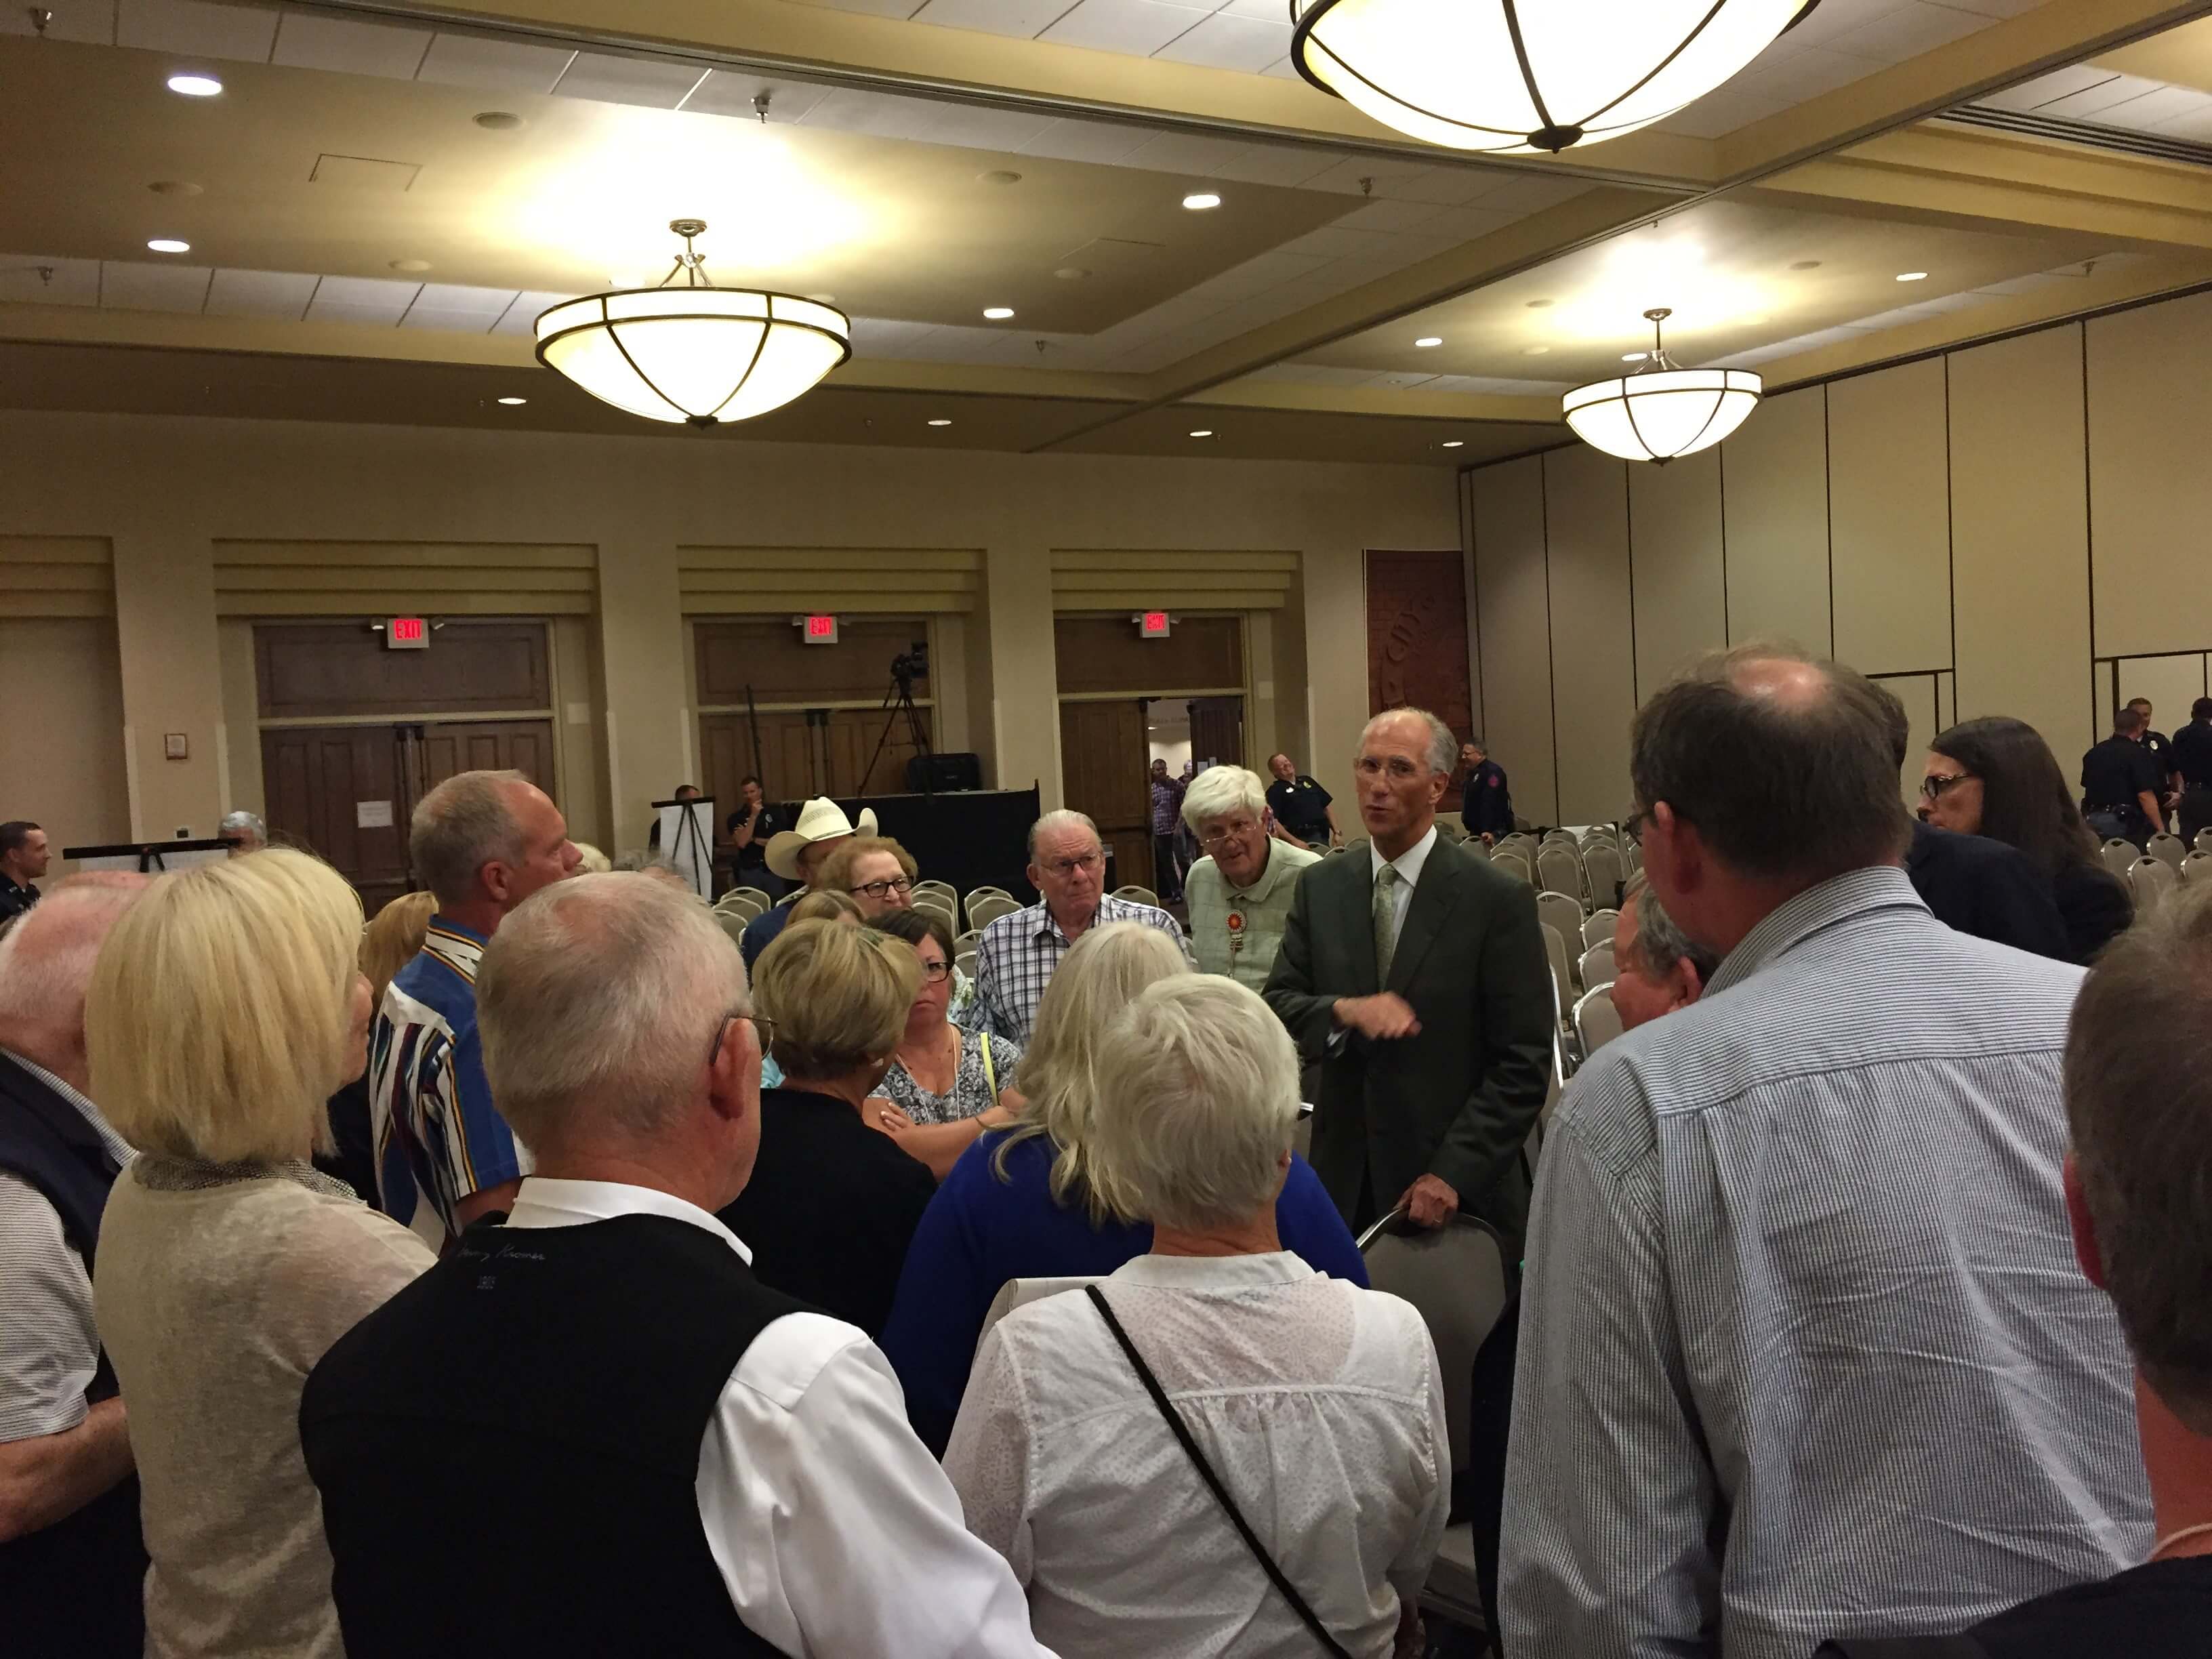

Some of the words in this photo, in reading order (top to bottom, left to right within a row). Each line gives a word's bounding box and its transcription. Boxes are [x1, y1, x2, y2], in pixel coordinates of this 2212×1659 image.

[394, 619, 422, 640] EXIT
[810, 617, 832, 635] EXIT
[1146, 614, 1165, 630] EXIT
